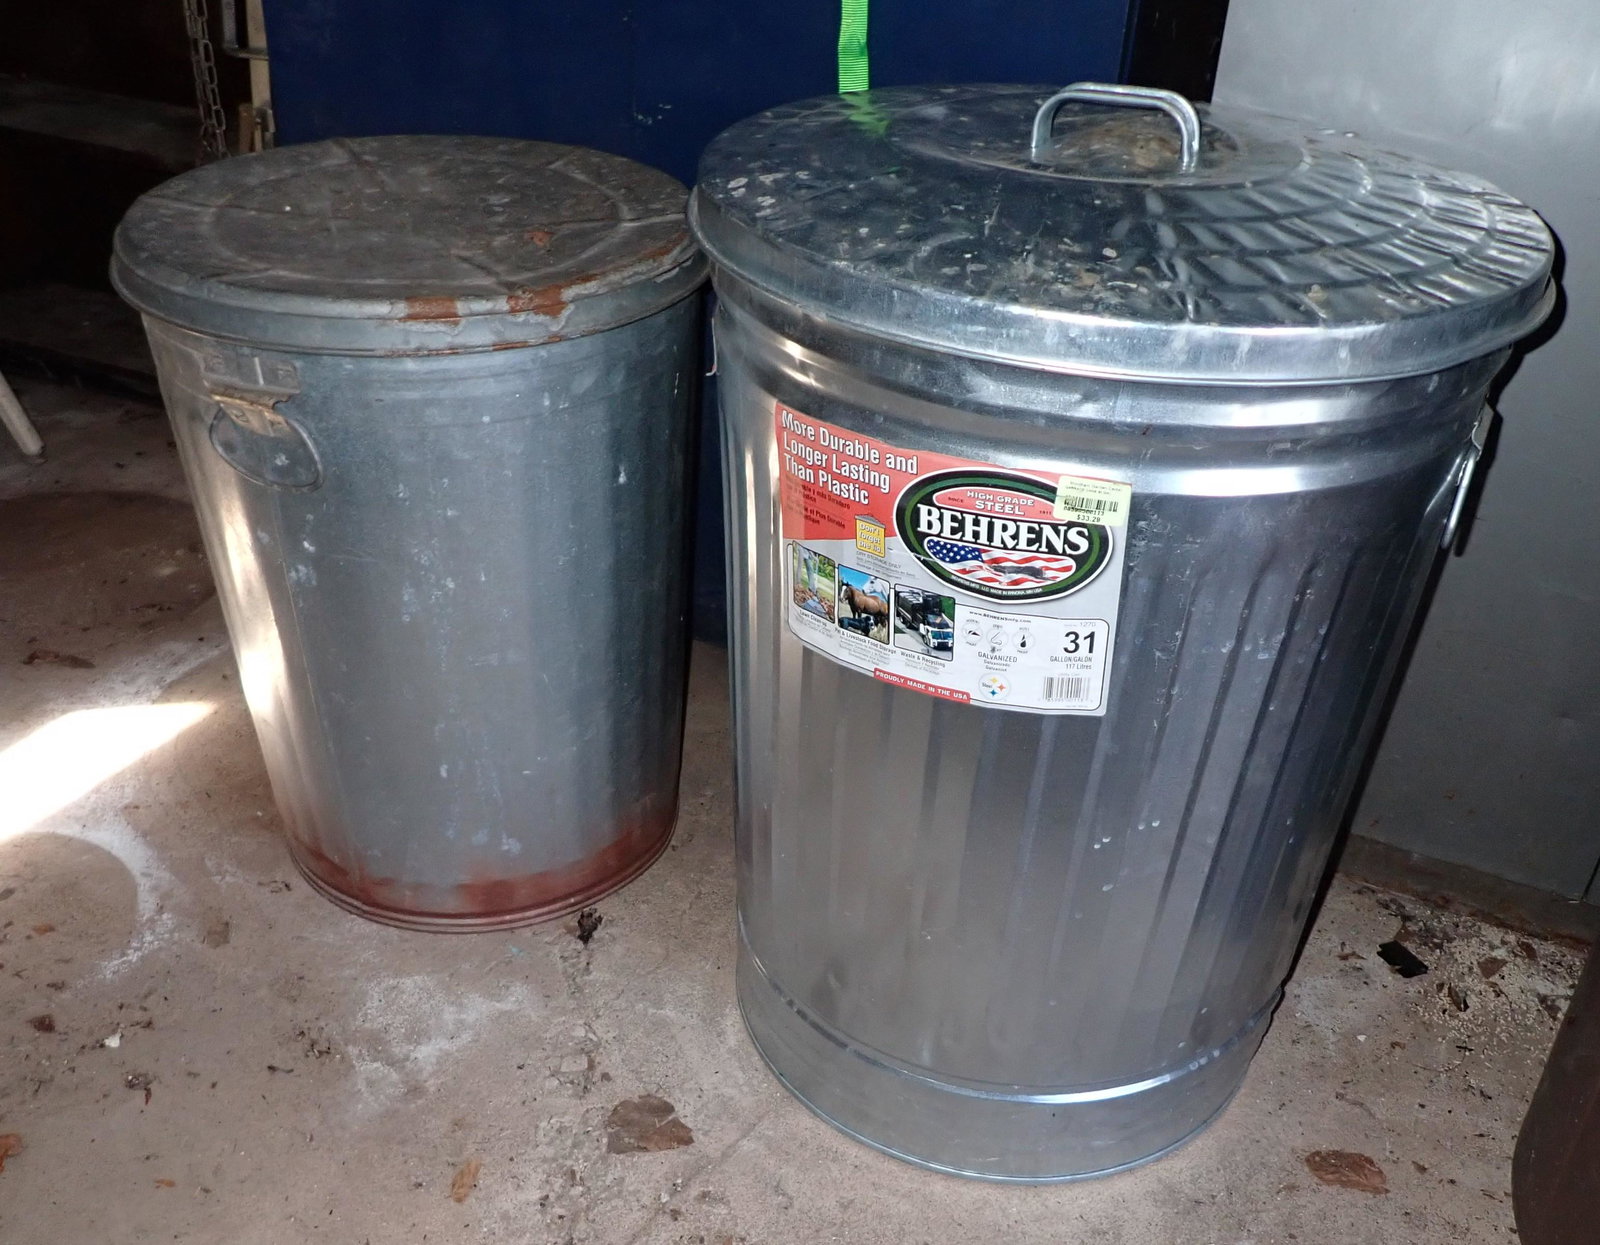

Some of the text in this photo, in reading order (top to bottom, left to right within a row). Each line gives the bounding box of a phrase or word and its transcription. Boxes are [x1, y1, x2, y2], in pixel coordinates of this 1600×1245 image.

[782, 410, 918, 475] More Durable and
[784, 431, 890, 493] Longer Lasting
[784, 453, 815, 484] Than
[819, 470, 869, 504] Plastic
[967, 490, 1034, 506] HIGH GRADE
[975, 500, 1025, 515] STEEL
[859, 531, 881, 546] forget
[917, 503, 1089, 555] BEHRENS
[1063, 631, 1095, 654] 31
[921, 656, 946, 668] Recycling
[978, 651, 1017, 663] GALVANIZED
[876, 670, 905, 683] PROUDLY
[907, 680, 926, 690] MADE
[937, 688, 951, 697] THE
[953, 692, 968, 700] USA
